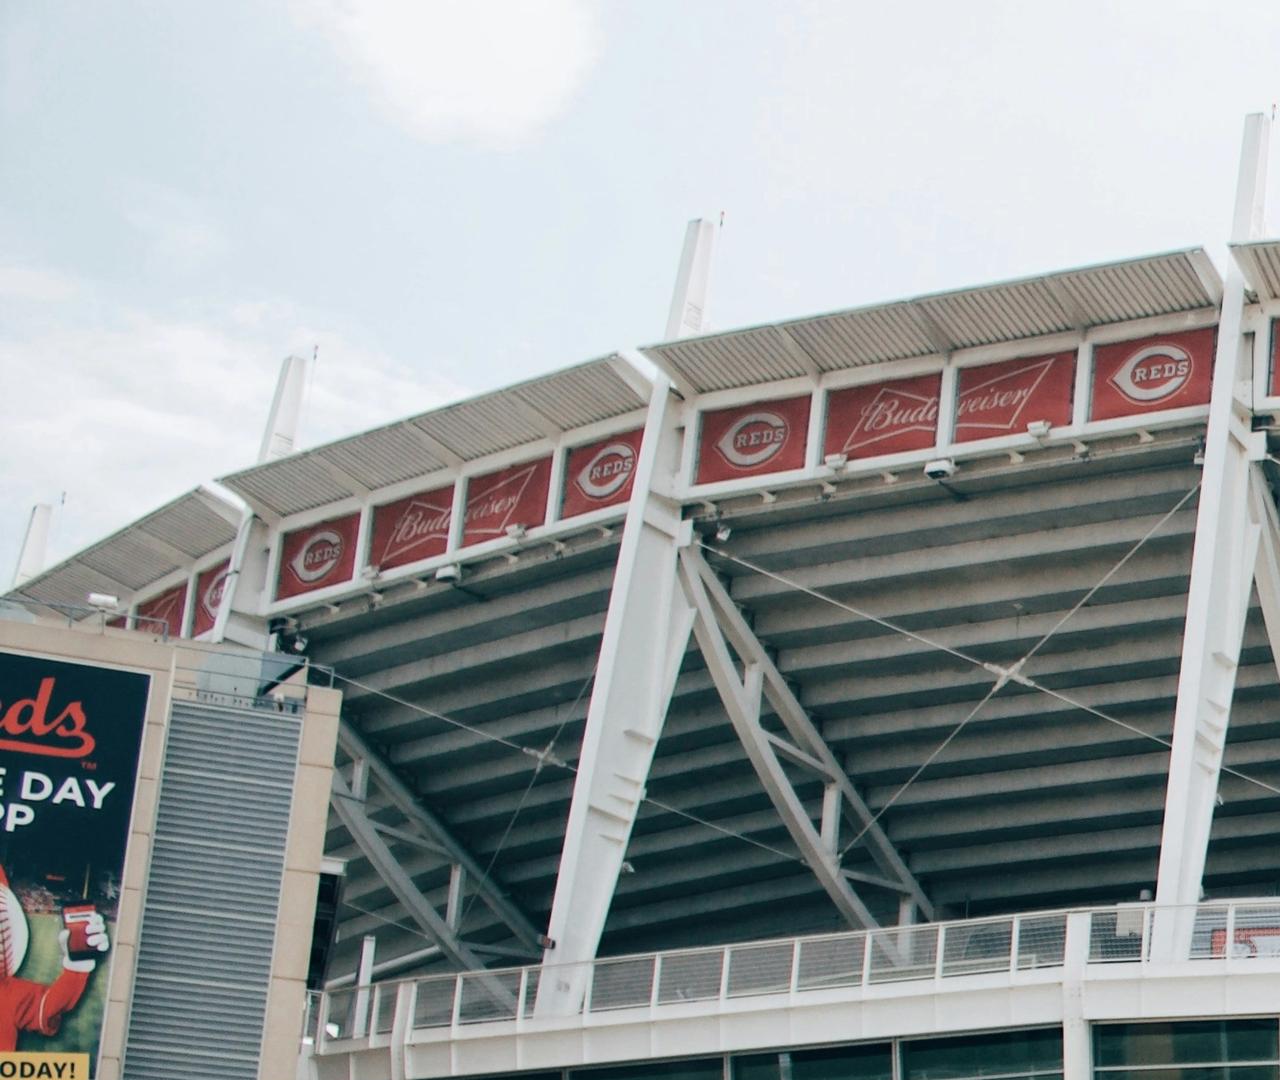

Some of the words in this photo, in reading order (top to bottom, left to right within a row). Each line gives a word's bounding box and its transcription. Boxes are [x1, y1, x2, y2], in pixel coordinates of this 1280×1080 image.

[1134, 361, 1189, 383] REDS
[735, 426, 786, 448] REDS
[589, 456, 634, 480] REDS
[304, 543, 341, 564] REDS
[21, 771, 116, 809] DAY
